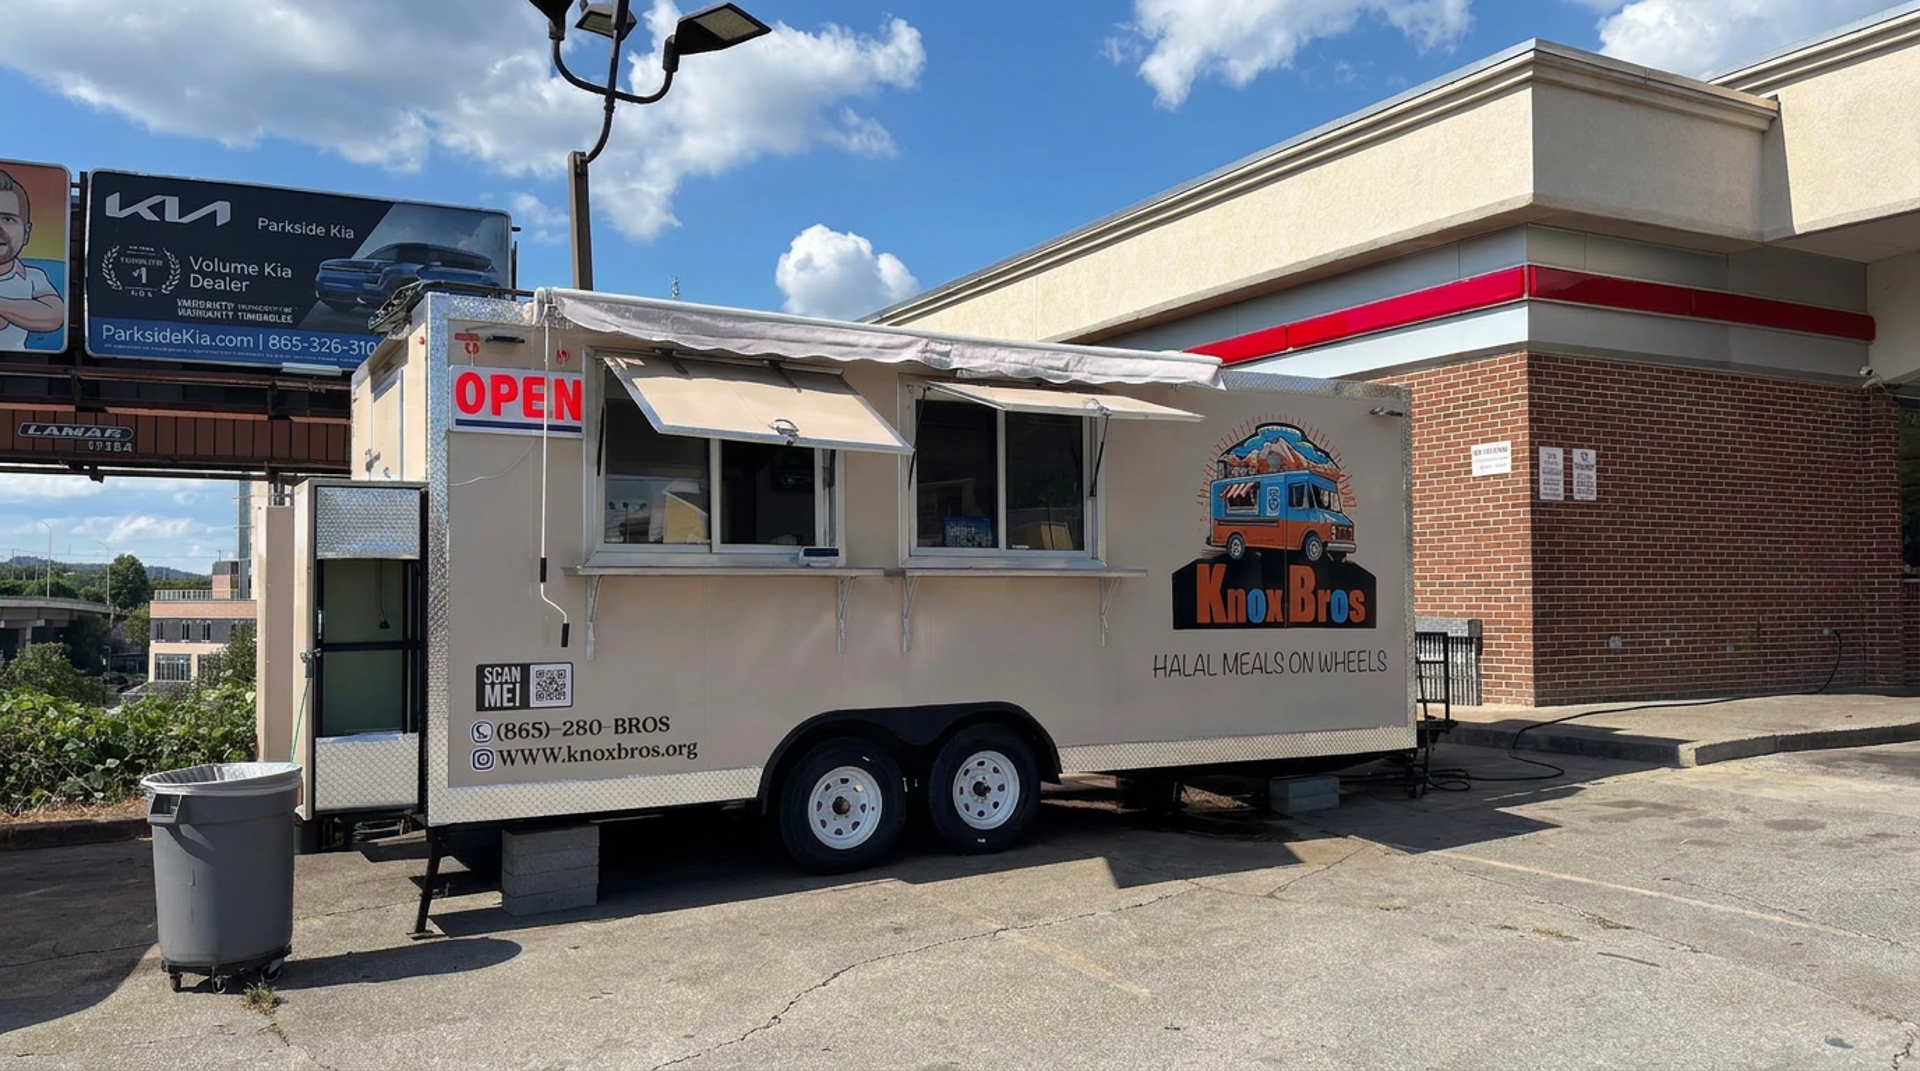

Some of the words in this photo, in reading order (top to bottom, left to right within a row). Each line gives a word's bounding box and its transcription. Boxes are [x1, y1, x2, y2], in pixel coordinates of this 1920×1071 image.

[105, 192, 231, 227] KIA
[258, 217, 326, 237] Parkside
[330, 224, 354, 239] Kia
[190, 256, 259, 276] Volume
[264, 262, 293, 279] Kia
[190, 273, 250, 292] Dealer
[102, 324, 254, 348] ParksideKia.com
[268, 335, 377, 355] 865-326-310
[455, 371, 583, 422] OPEN
[27, 425, 122, 438] LAMAR
[484, 665, 521, 684] SCAN
[1153, 653, 1217, 678] HALAL
[1222, 651, 1284, 676] MEALS
[1289, 651, 1314, 674] ON
[1319, 649, 1388, 674] WHEELS
[497, 741, 699, 767] WWW.knoxbros.org
